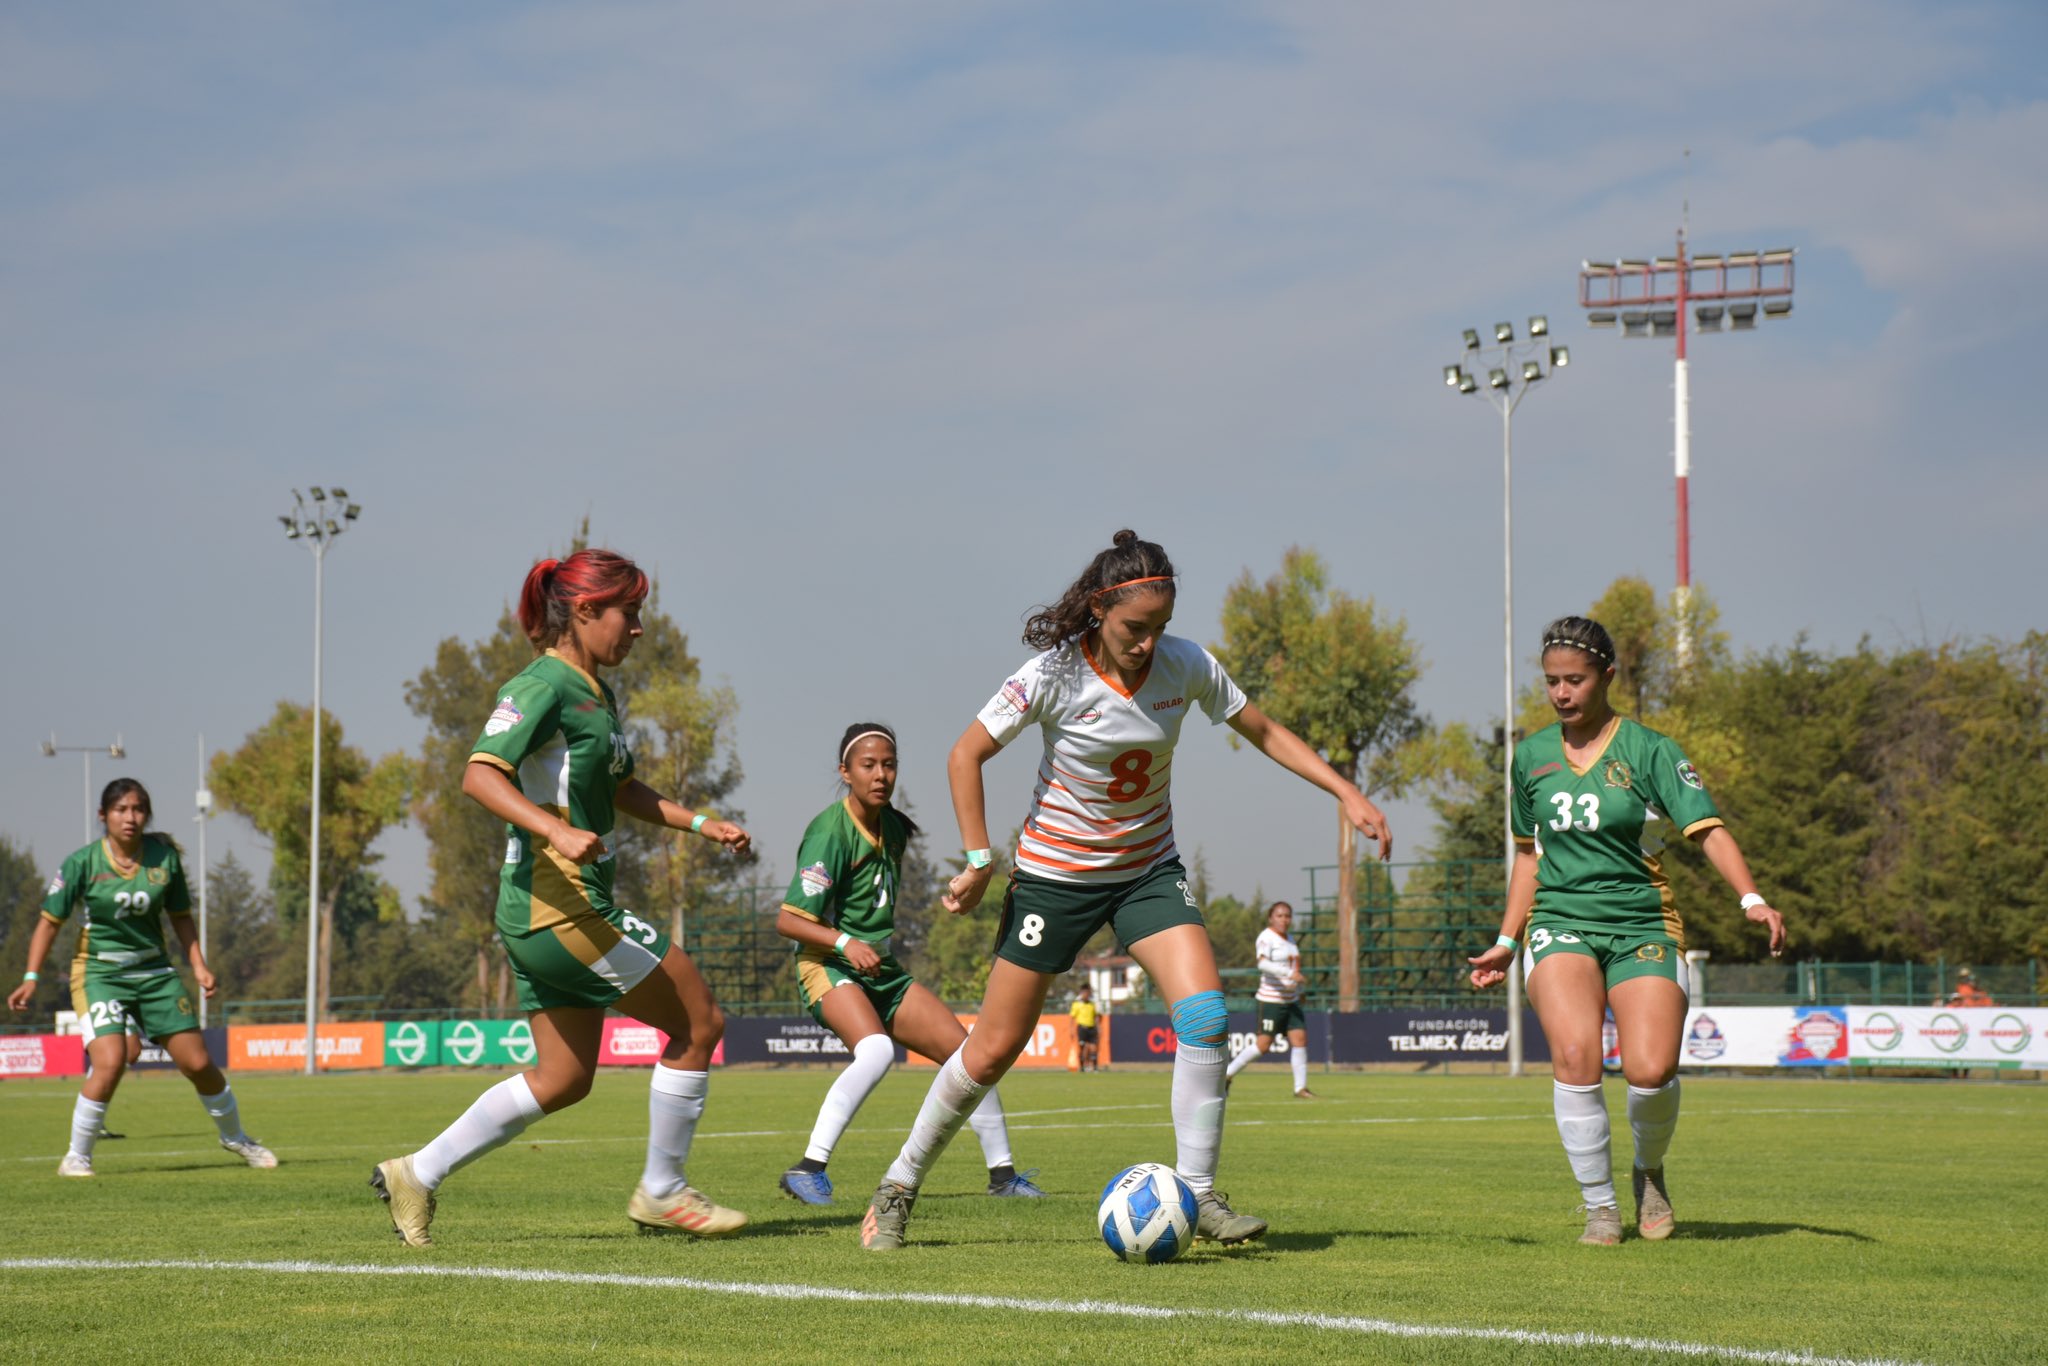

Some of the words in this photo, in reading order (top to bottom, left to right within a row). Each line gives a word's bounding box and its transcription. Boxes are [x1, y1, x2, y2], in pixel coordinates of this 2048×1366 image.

[1153, 697, 1184, 711] UDLAP
[1106, 749, 1153, 803] 8
[1549, 791, 1600, 832] 33
[872, 871, 895, 908] 31
[114, 890, 151, 920] 29
[623, 909, 657, 945] 3
[1019, 914, 1045, 947] 8
[90, 999, 124, 1028] 29
[1262, 1018, 1274, 1031] 11
[1408, 1017, 1489, 1031] FUNDACIÓN
[765, 1038, 819, 1053] TELMEX
[1388, 1035, 1459, 1051] TELMEX
